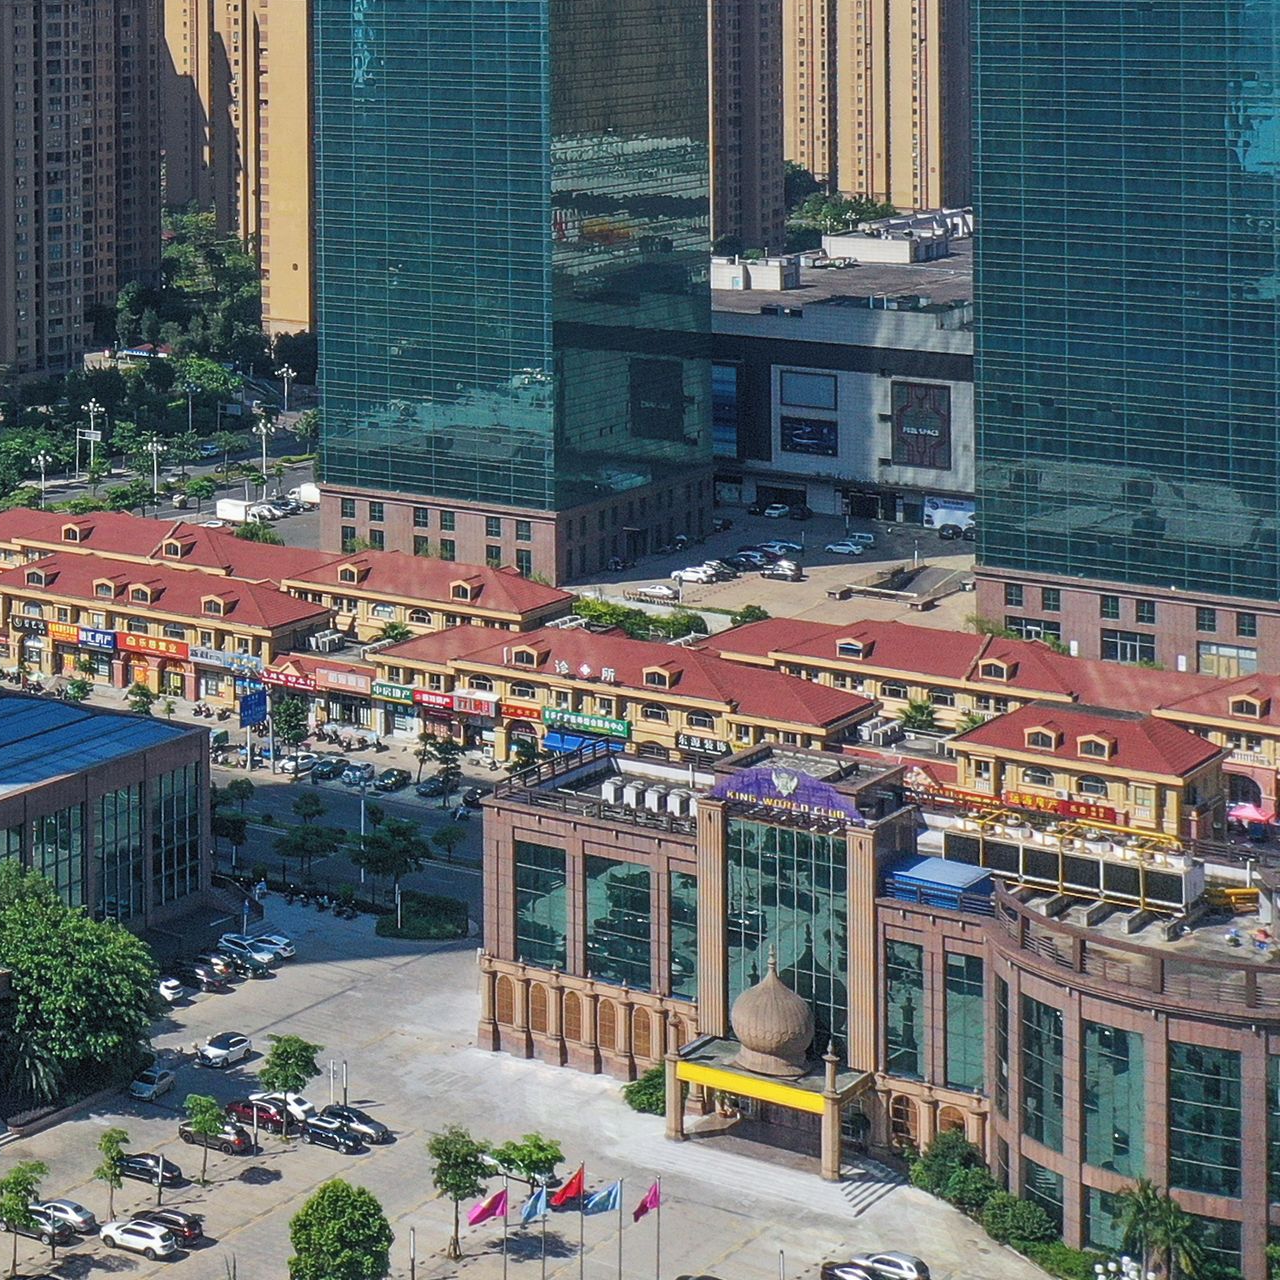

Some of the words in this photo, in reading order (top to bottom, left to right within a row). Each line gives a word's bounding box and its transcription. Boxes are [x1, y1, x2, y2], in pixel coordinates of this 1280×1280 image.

[726, 790, 756, 803] KING
[763, 797, 809, 813] WORLD
[813, 805, 845, 819] CLUB
